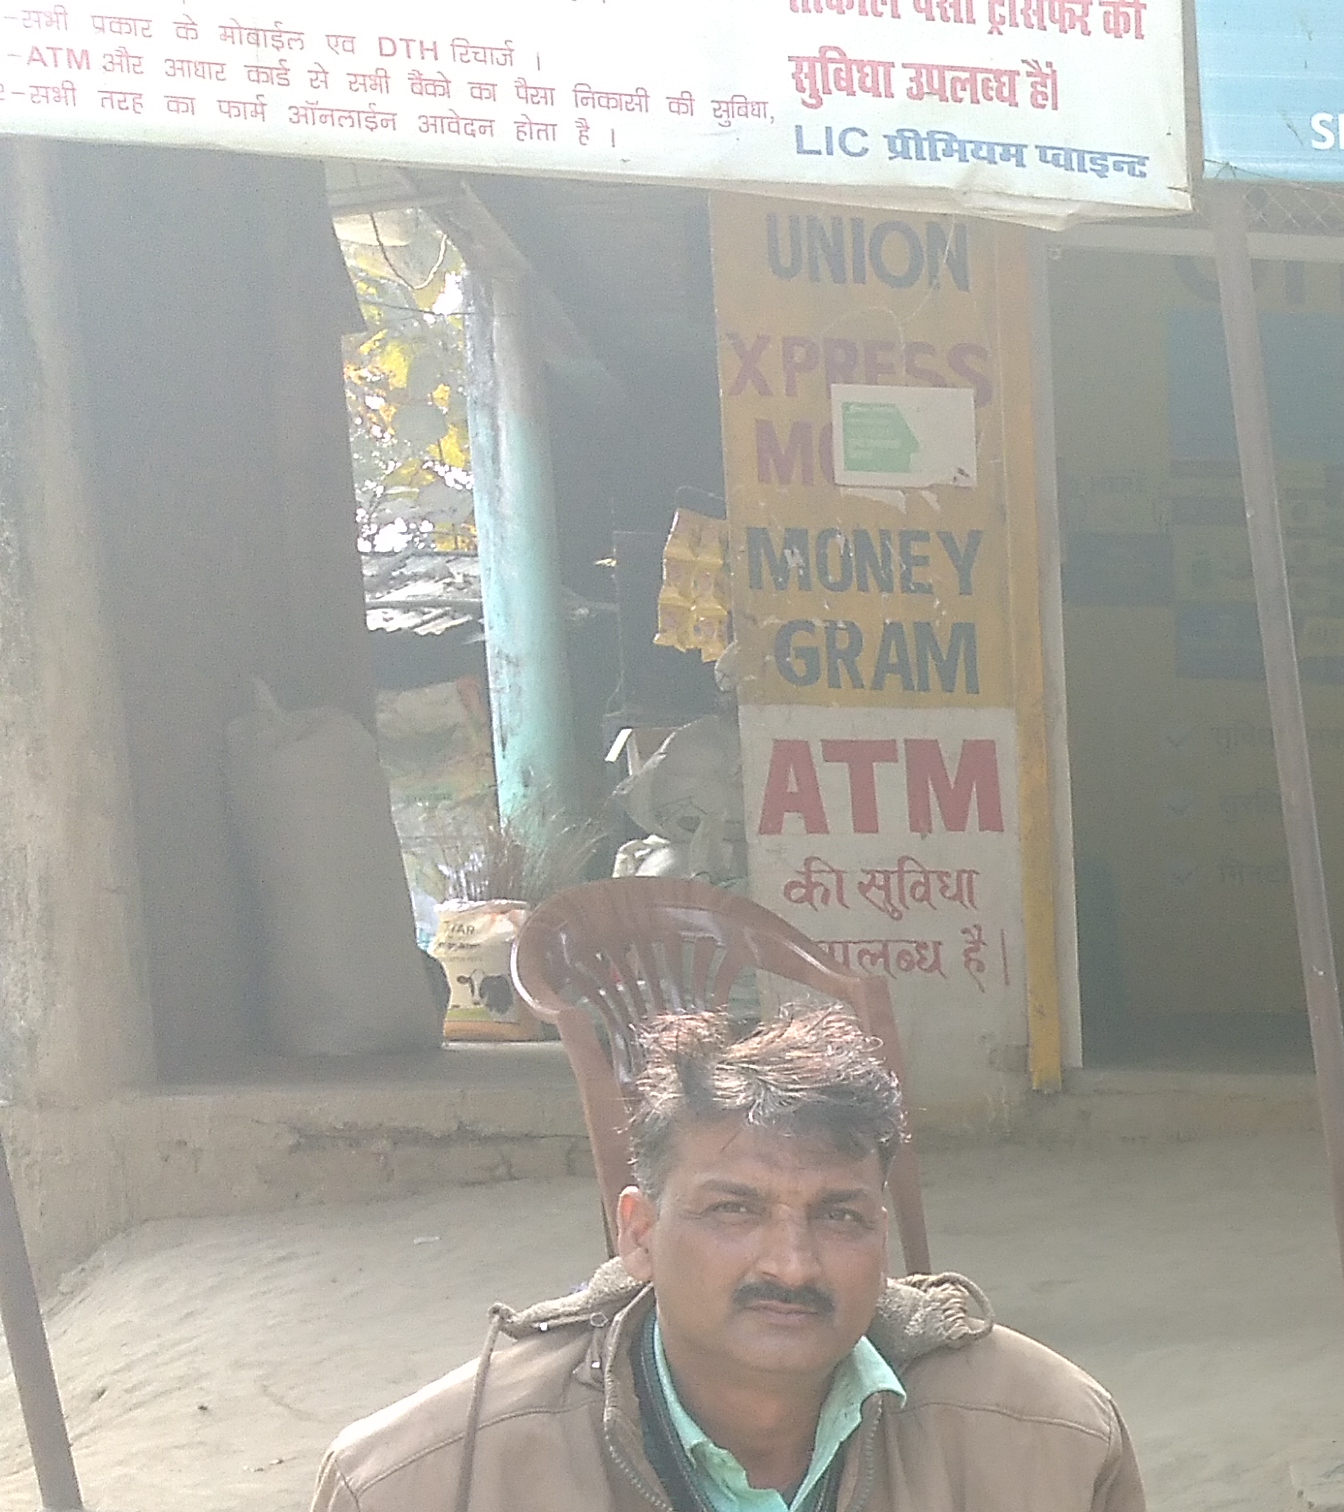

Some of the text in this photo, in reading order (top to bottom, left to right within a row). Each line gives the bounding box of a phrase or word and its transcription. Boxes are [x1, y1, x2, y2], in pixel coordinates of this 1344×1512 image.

[91, 14, 154, 38] प्रकार
[173, 14, 199, 41] के
[218, 18, 305, 51] मोबाईल
[378, 37, 439, 61] DTH
[450, 38, 515, 67] रिचार्ज
[103, 47, 144, 75] और
[165, 58, 227, 82] आधार
[243, 58, 291, 88] कार्ड
[307, 62, 329, 90] से
[346, 68, 391, 95] सभी
[467, 81, 498, 102] का
[514, 77, 556, 107] पैसा
[572, 83, 651, 114] निकासी
[666, 91, 695, 117] की
[902, 62, 1020, 108] उपलब्ध
[98, 89, 144, 115] तरह
[164, 94, 196, 116] का
[217, 94, 267, 123] फार्म
[418, 109, 496, 137] आवेदन
[513, 113, 557, 142] होता
[575, 118, 591, 146] है
[795, 125, 869, 157] LIC
[883, 129, 1028, 167] प्रीमियम
[766, 213, 971, 292] UNION
[745, 525, 985, 597] MONEY
[773, 619, 980, 695] GRAM
[757, 737, 1004, 836] ATM
[783, 855, 980, 921] की सुविधा
